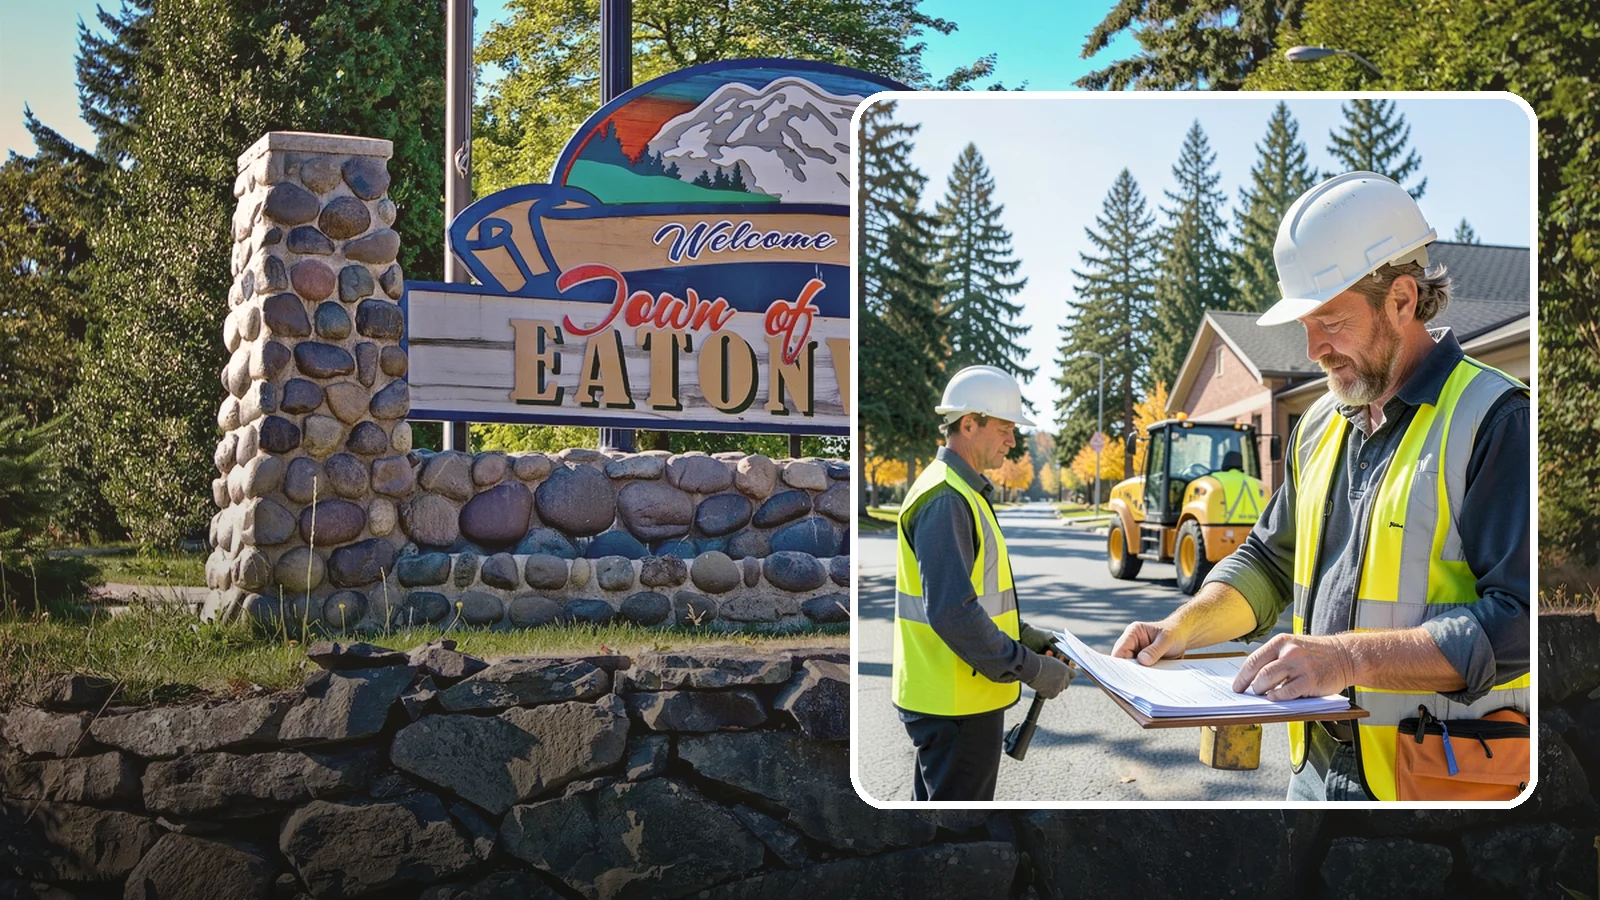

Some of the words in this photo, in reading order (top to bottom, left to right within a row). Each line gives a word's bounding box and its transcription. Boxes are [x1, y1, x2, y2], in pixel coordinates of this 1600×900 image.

[653, 221, 837, 263] Welcome
[557, 263, 738, 336] Town
[765, 278, 826, 366] of
